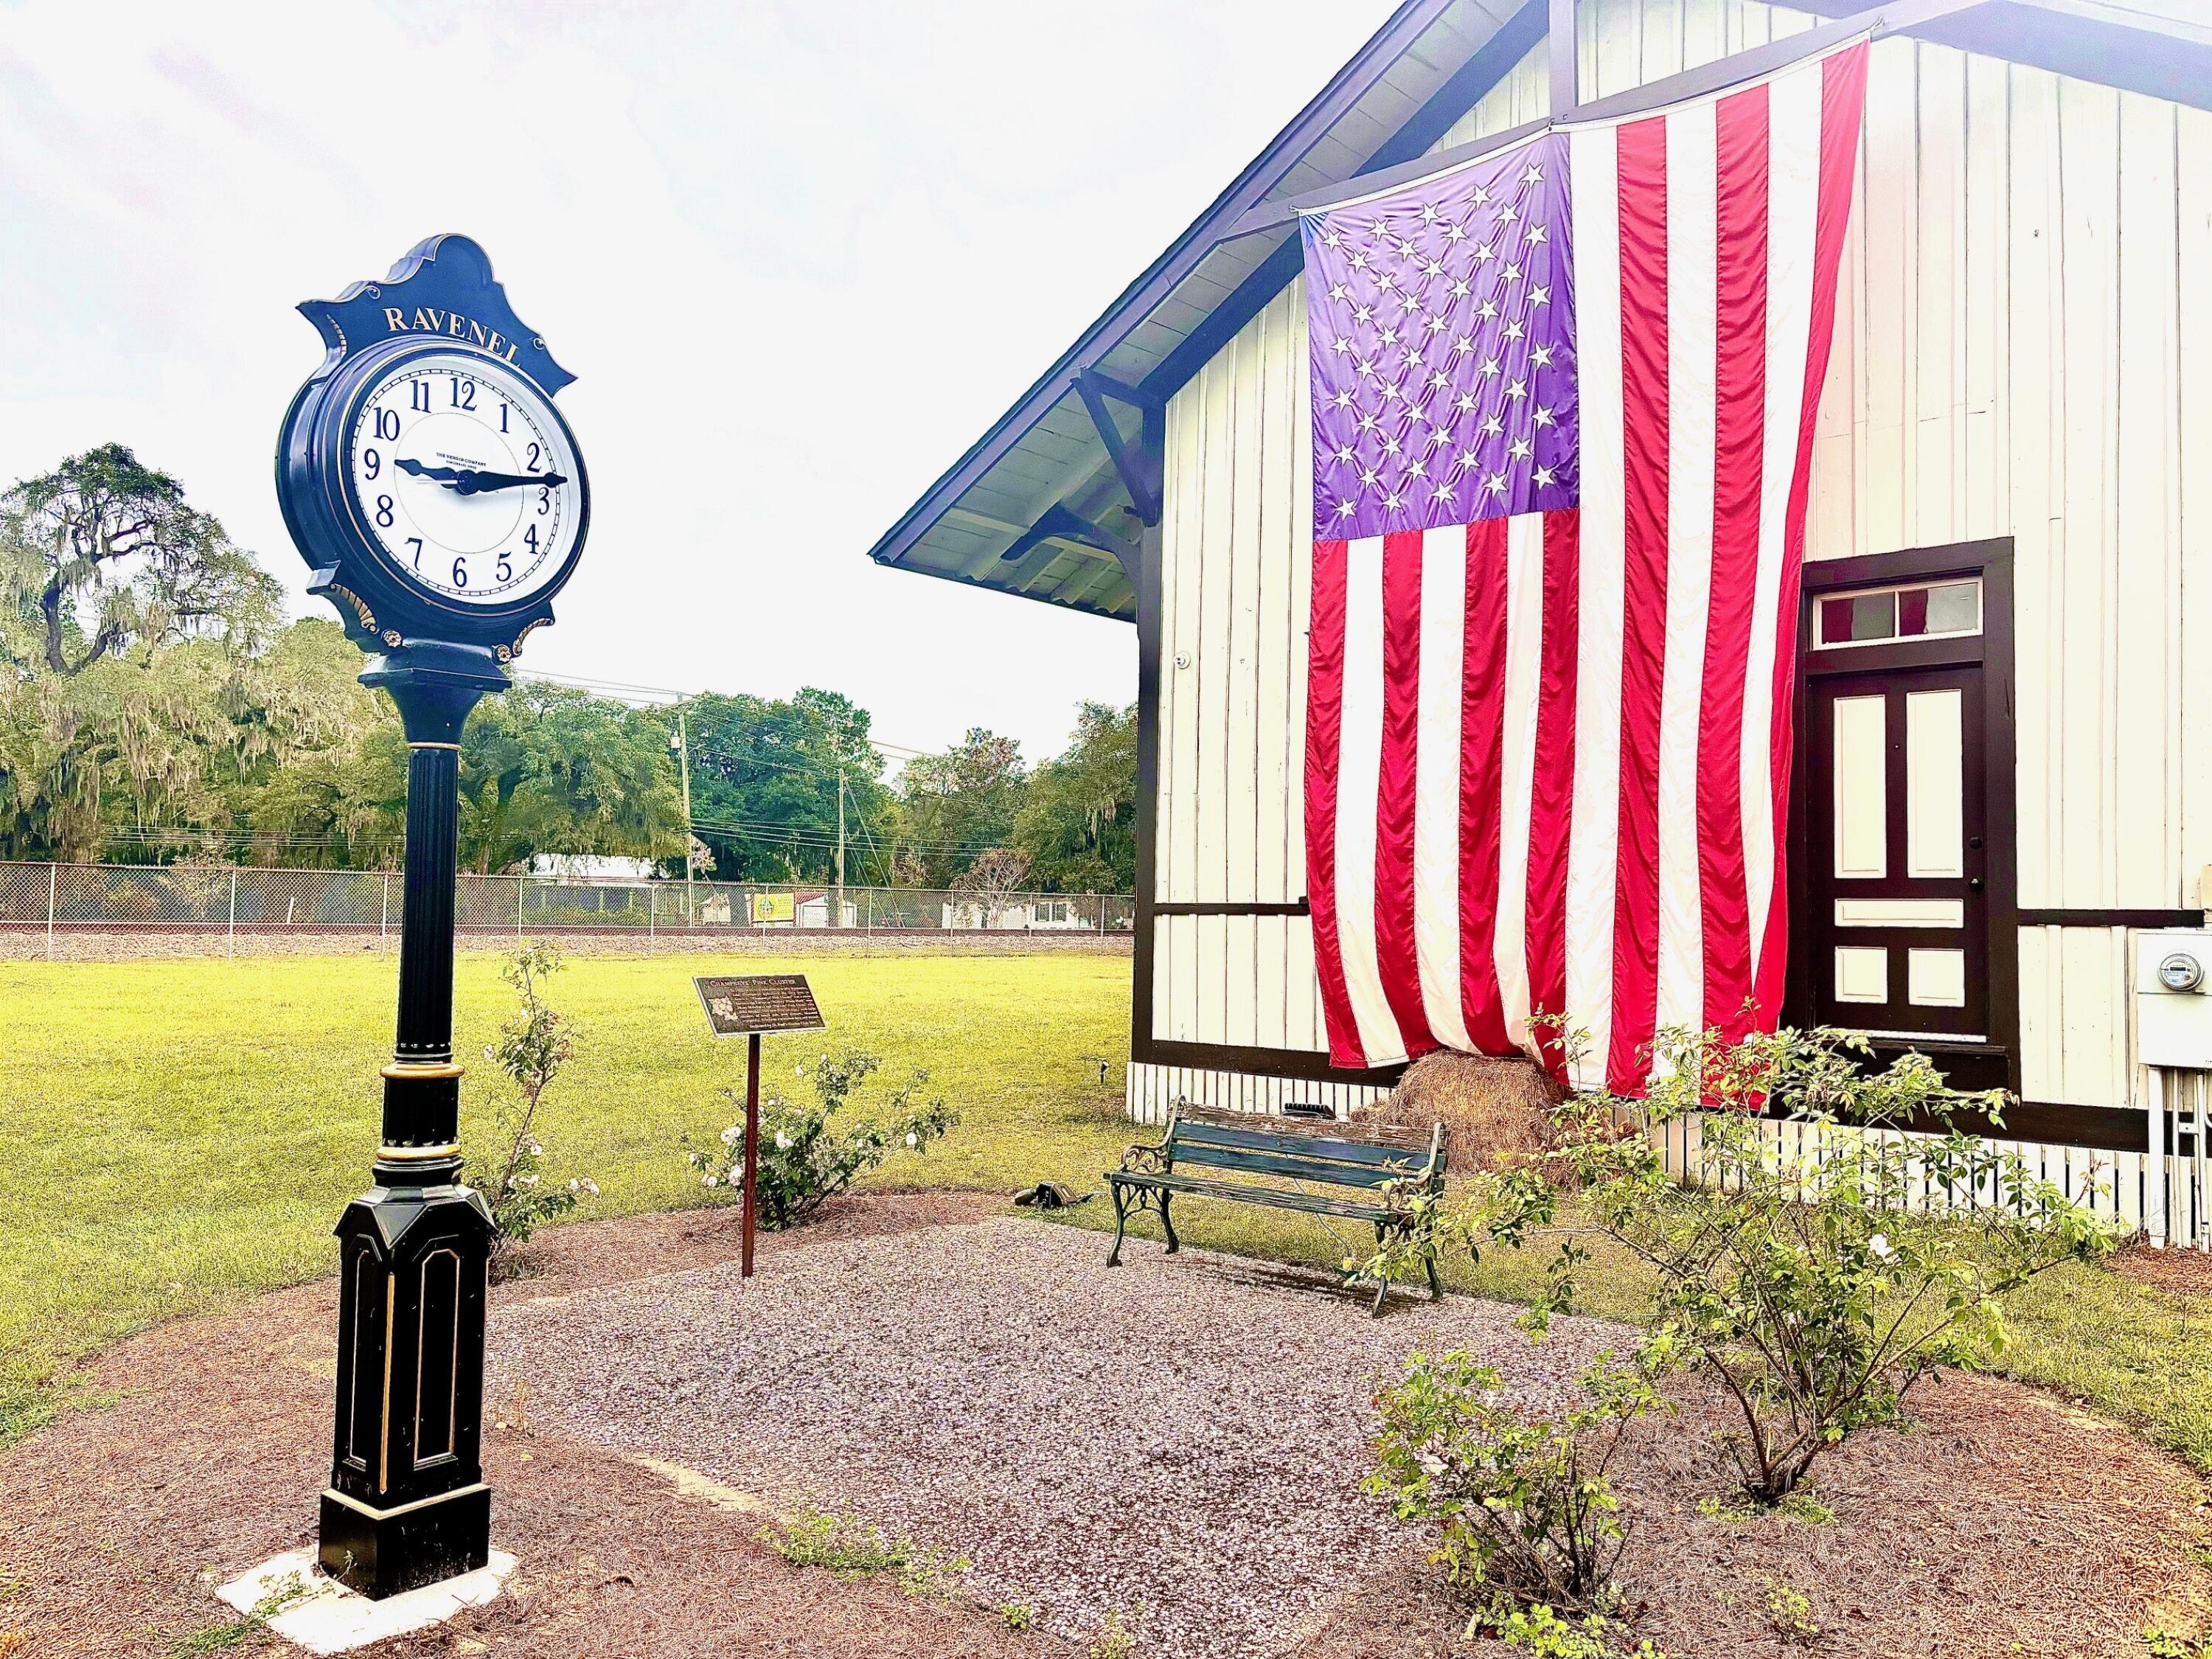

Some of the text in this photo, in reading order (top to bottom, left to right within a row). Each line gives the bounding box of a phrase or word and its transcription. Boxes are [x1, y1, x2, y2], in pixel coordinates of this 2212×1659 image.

[382, 307, 521, 367] RAVENEL
[410, 379, 431, 414] 11
[450, 377, 478, 411] 12
[373, 406, 400, 442] 10
[499, 403, 509, 434] 1
[364, 448, 380, 481] 9
[465, 459, 487, 467] COMPANY
[526, 442, 541, 473] 2
[375, 494, 394, 528] 8
[537, 487, 550, 515] 3
[404, 537, 423, 571] 7
[524, 524, 540, 555] 4
[452, 556, 467, 588] 6
[495, 551, 512, 582] 5
